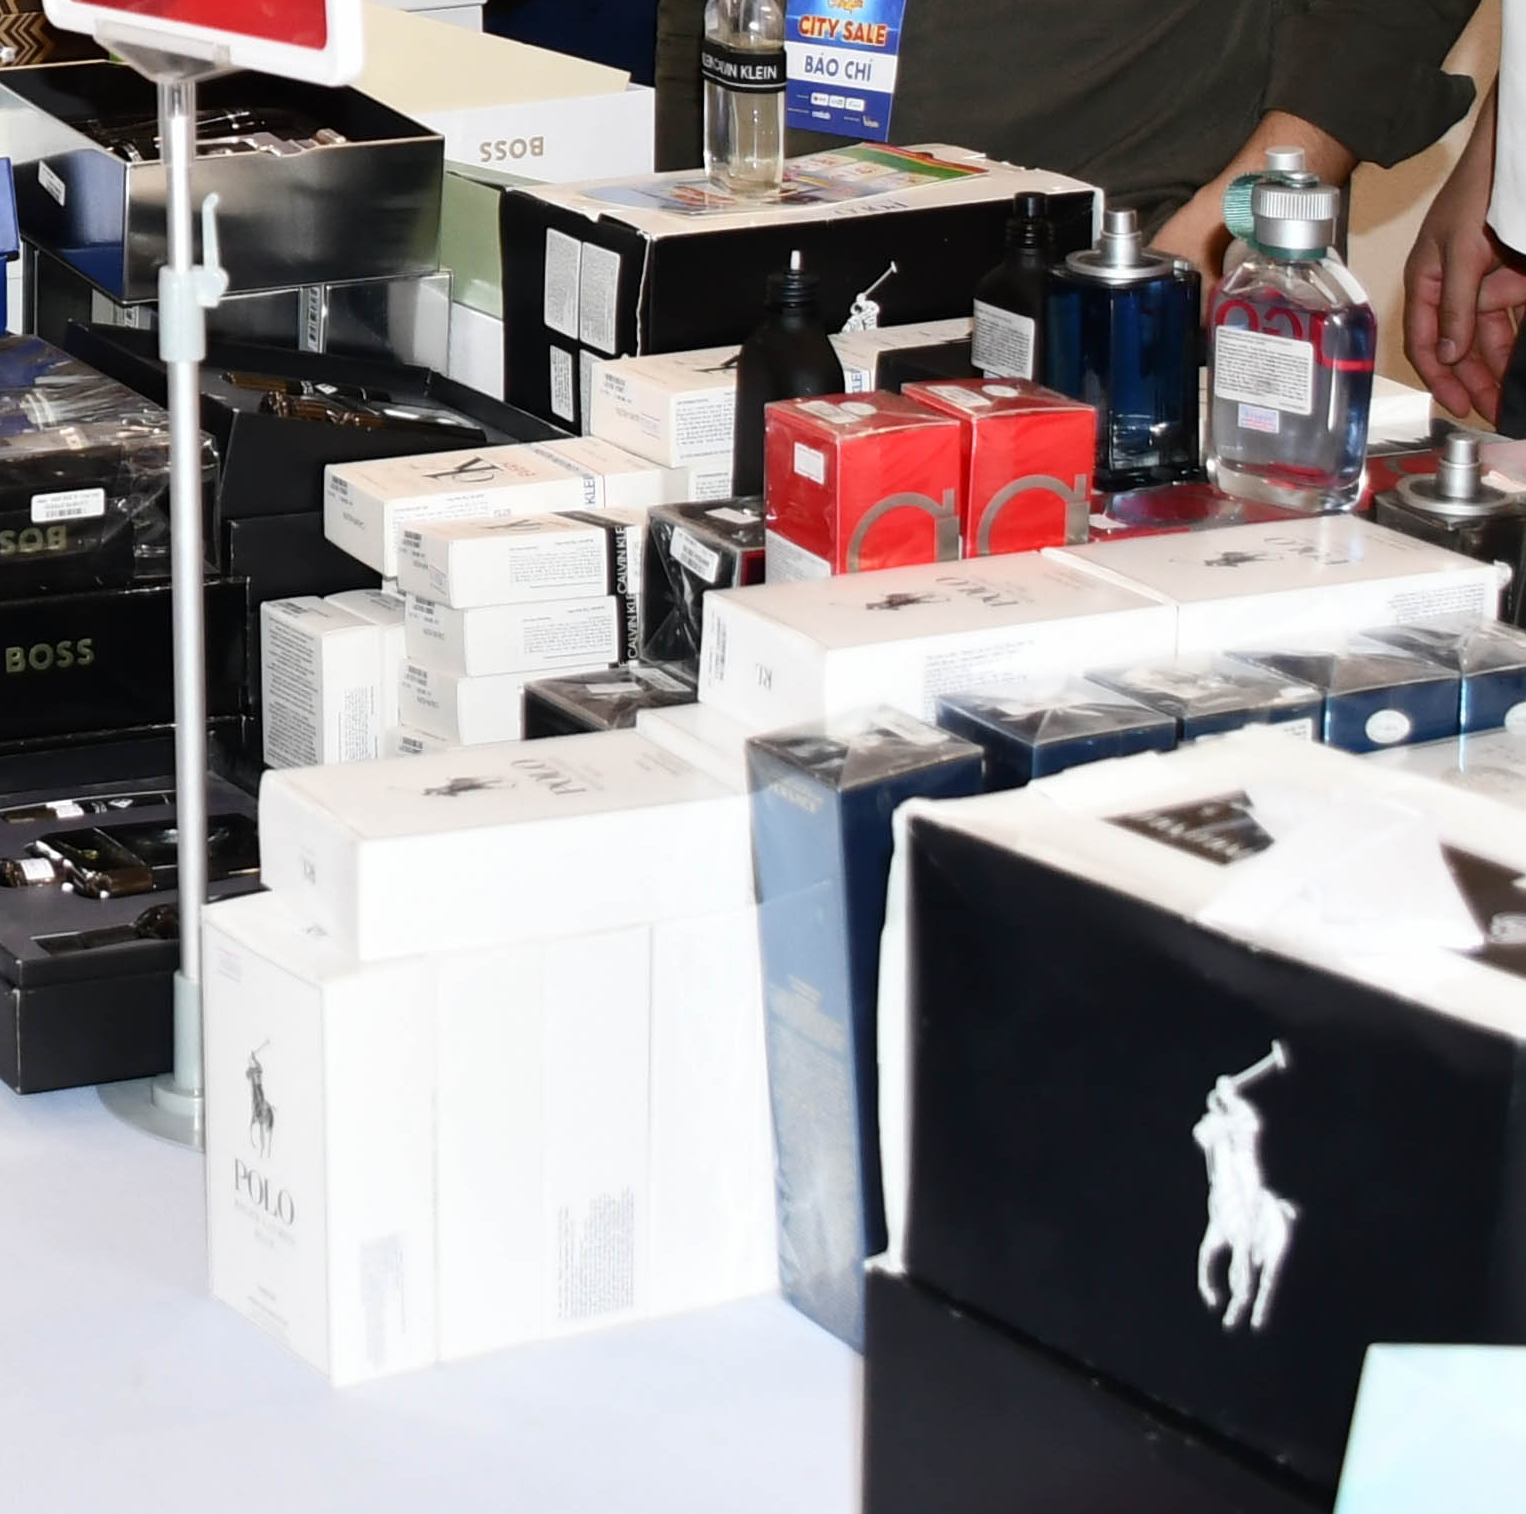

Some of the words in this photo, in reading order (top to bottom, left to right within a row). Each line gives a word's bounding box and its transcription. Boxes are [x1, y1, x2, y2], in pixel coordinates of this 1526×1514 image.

[798, 13, 838, 38] CITY
[843, 20, 888, 47] SALE
[740, 65, 777, 80] KLEIN
[804, 51, 839, 77] BÁO
[844, 58, 873, 82] CHÍ
[479, 136, 544, 163] BOSS
[616, 553, 627, 595] CALVIN
[627, 617, 638, 659] CALVIN
[5, 638, 94, 673] BOSS
[235, 1157, 295, 1226] POLO
